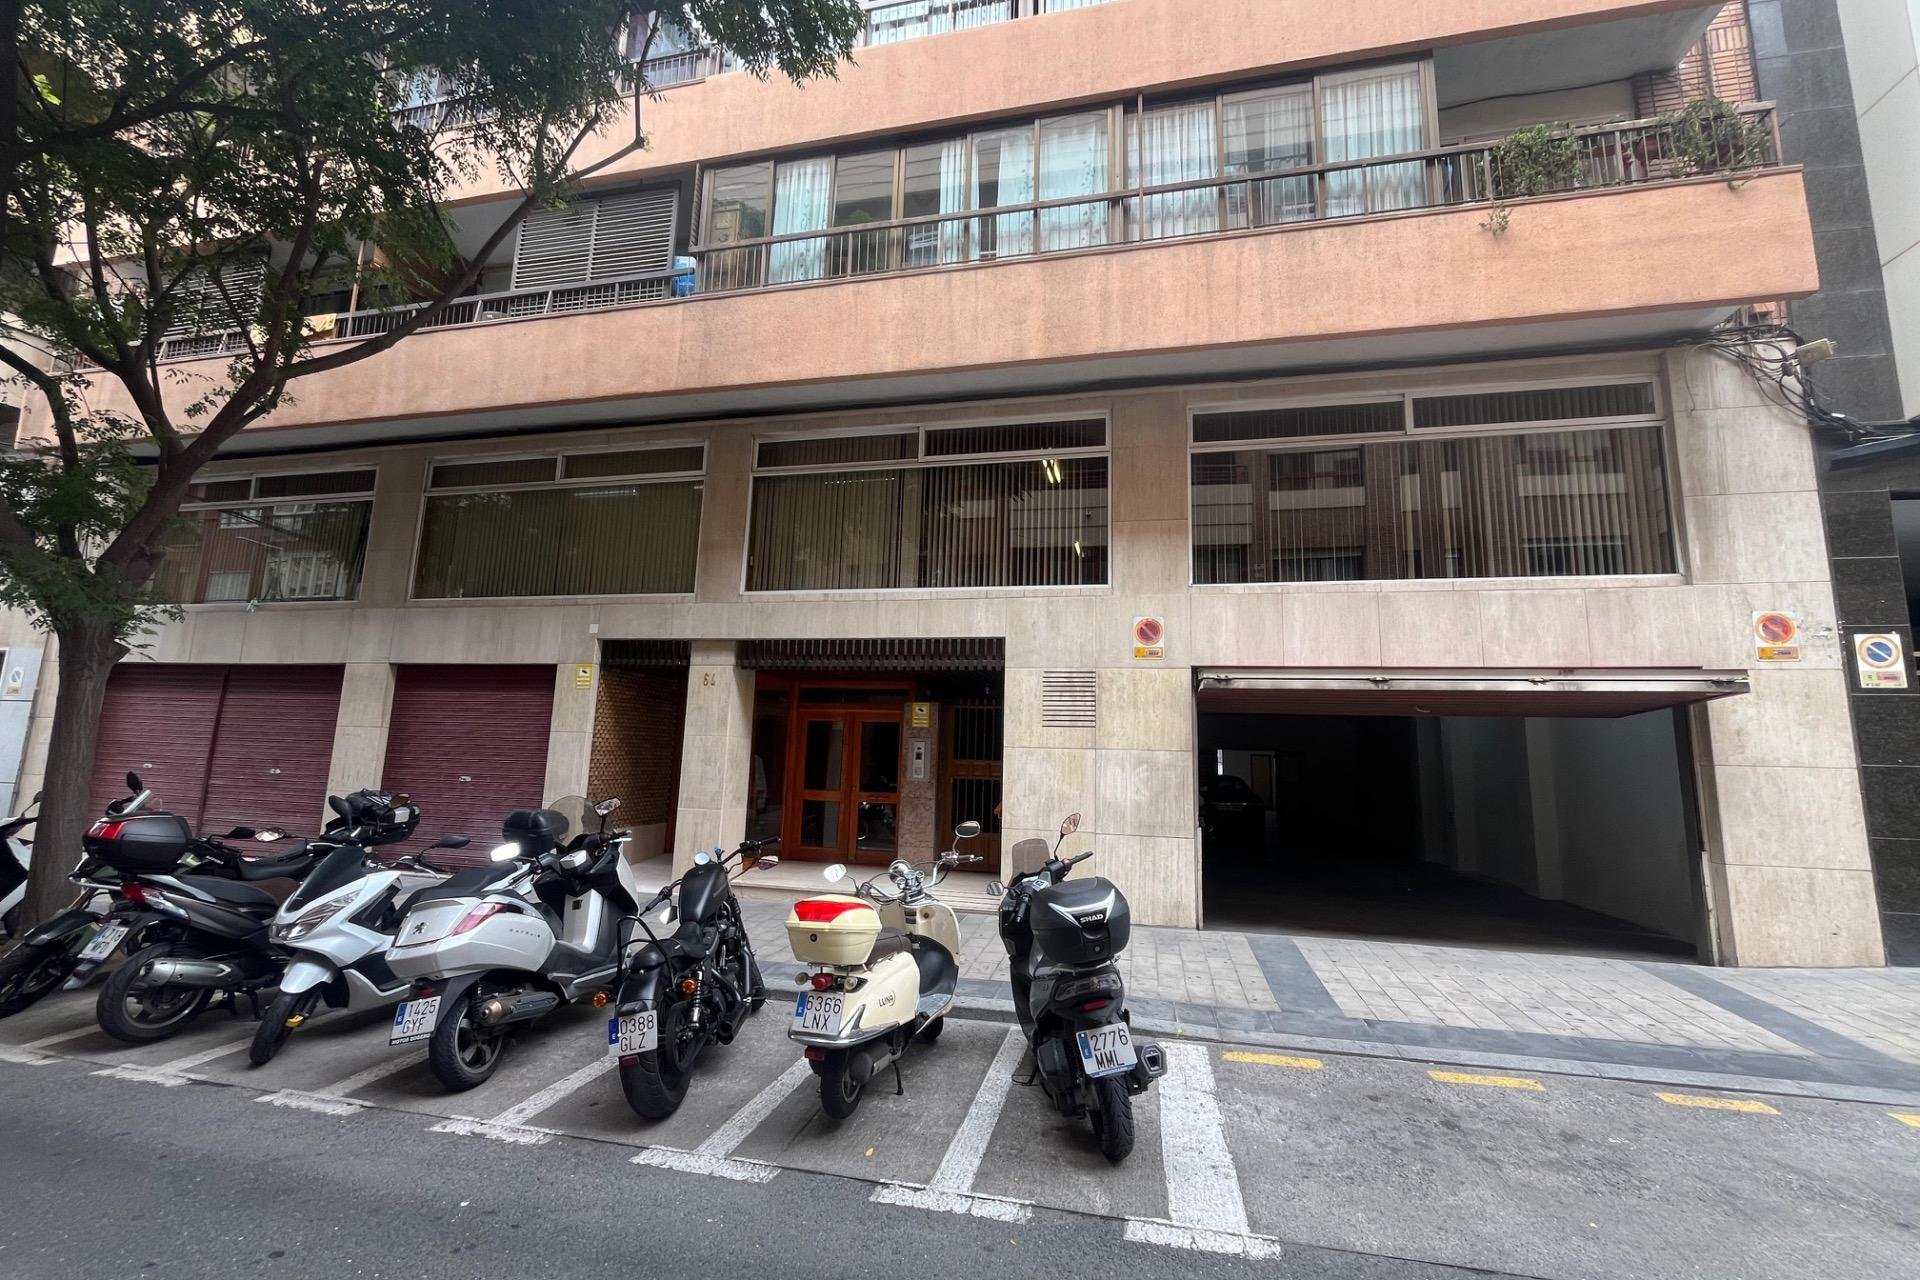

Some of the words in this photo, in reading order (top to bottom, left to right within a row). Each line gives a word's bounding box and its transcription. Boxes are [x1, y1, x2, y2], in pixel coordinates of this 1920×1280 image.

[703, 673, 716, 686] 64
[1080, 914, 1104, 923] SHAD
[409, 1000, 436, 1017] 1425
[806, 995, 842, 1014] 6366
[403, 1017, 426, 1033] GYF
[620, 1014, 654, 1035] 0388
[803, 1012, 831, 1031] LNX
[620, 1032, 646, 1052] GLZ
[1090, 1028, 1128, 1051] 2776
[1095, 1050, 1124, 1070] MML
